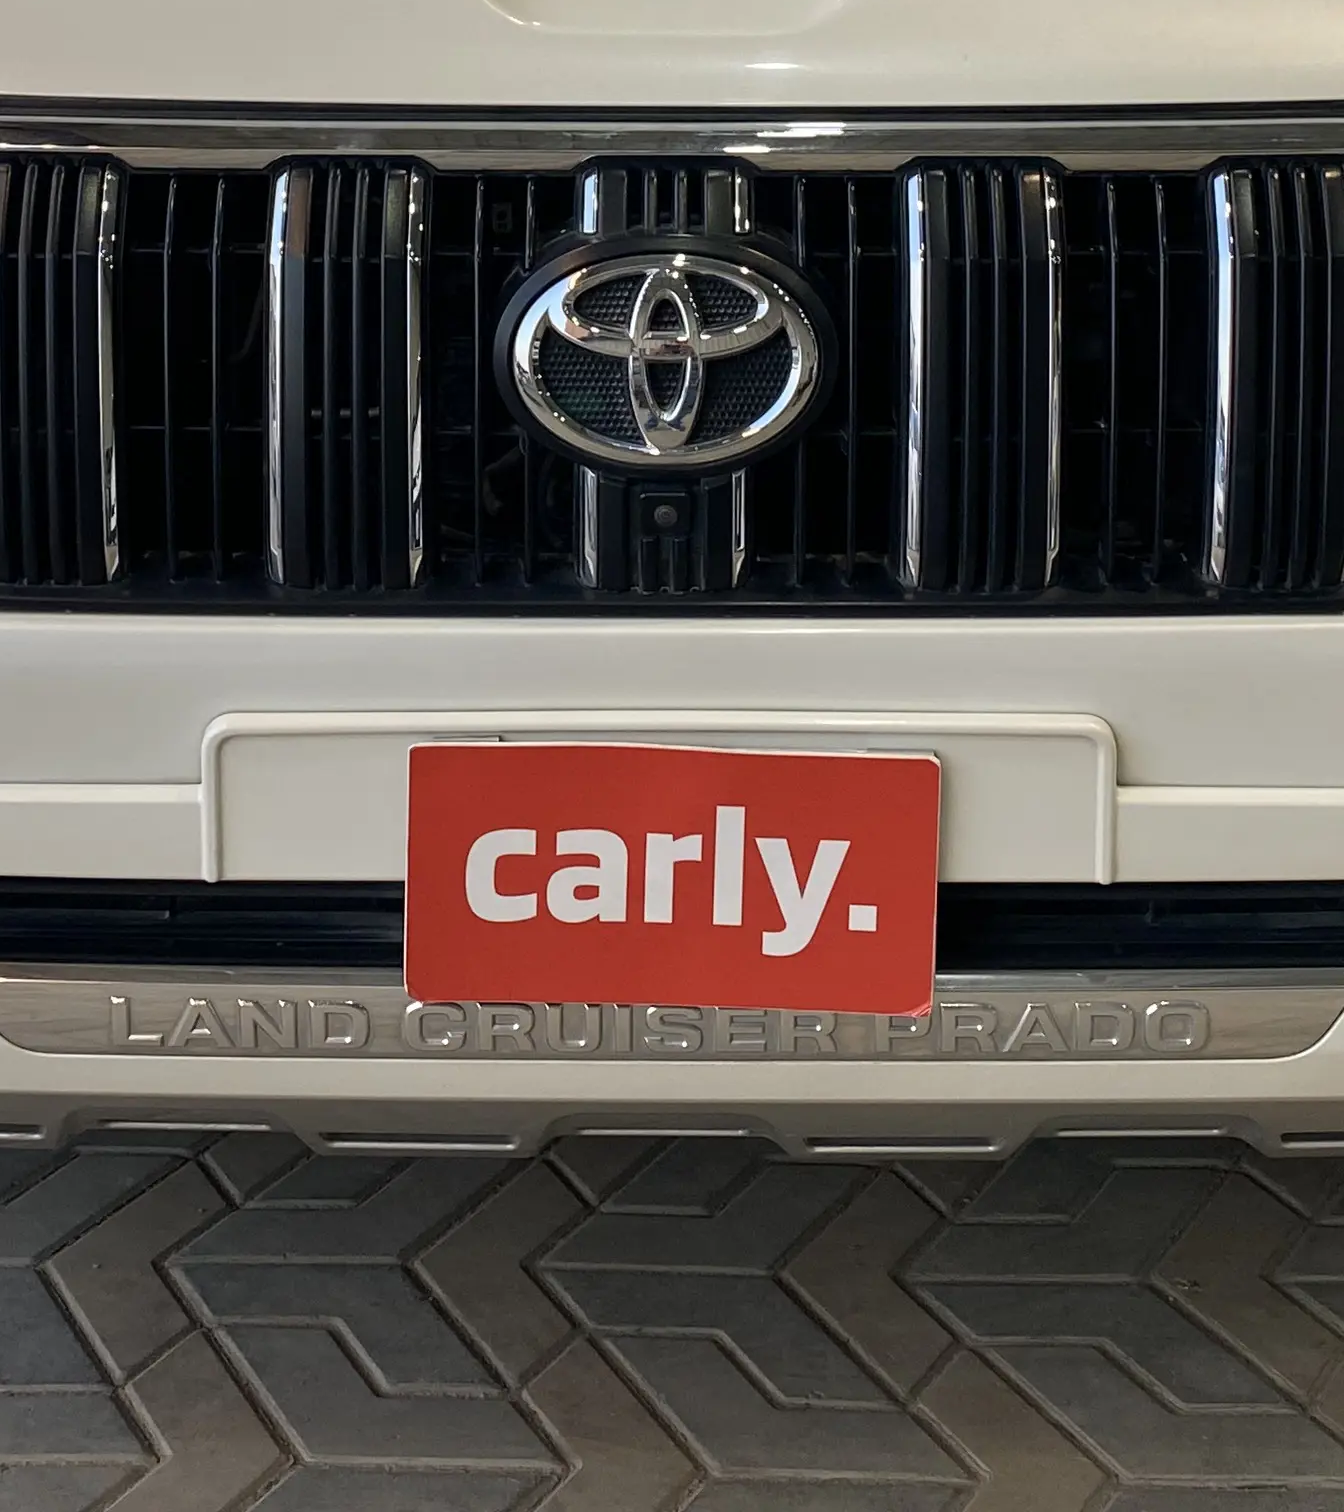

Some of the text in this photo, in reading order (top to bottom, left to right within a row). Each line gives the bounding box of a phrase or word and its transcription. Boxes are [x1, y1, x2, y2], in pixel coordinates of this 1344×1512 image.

[463, 804, 879, 957] carly.
[109, 995, 1213, 1055] LAND CRUISER PRADO
